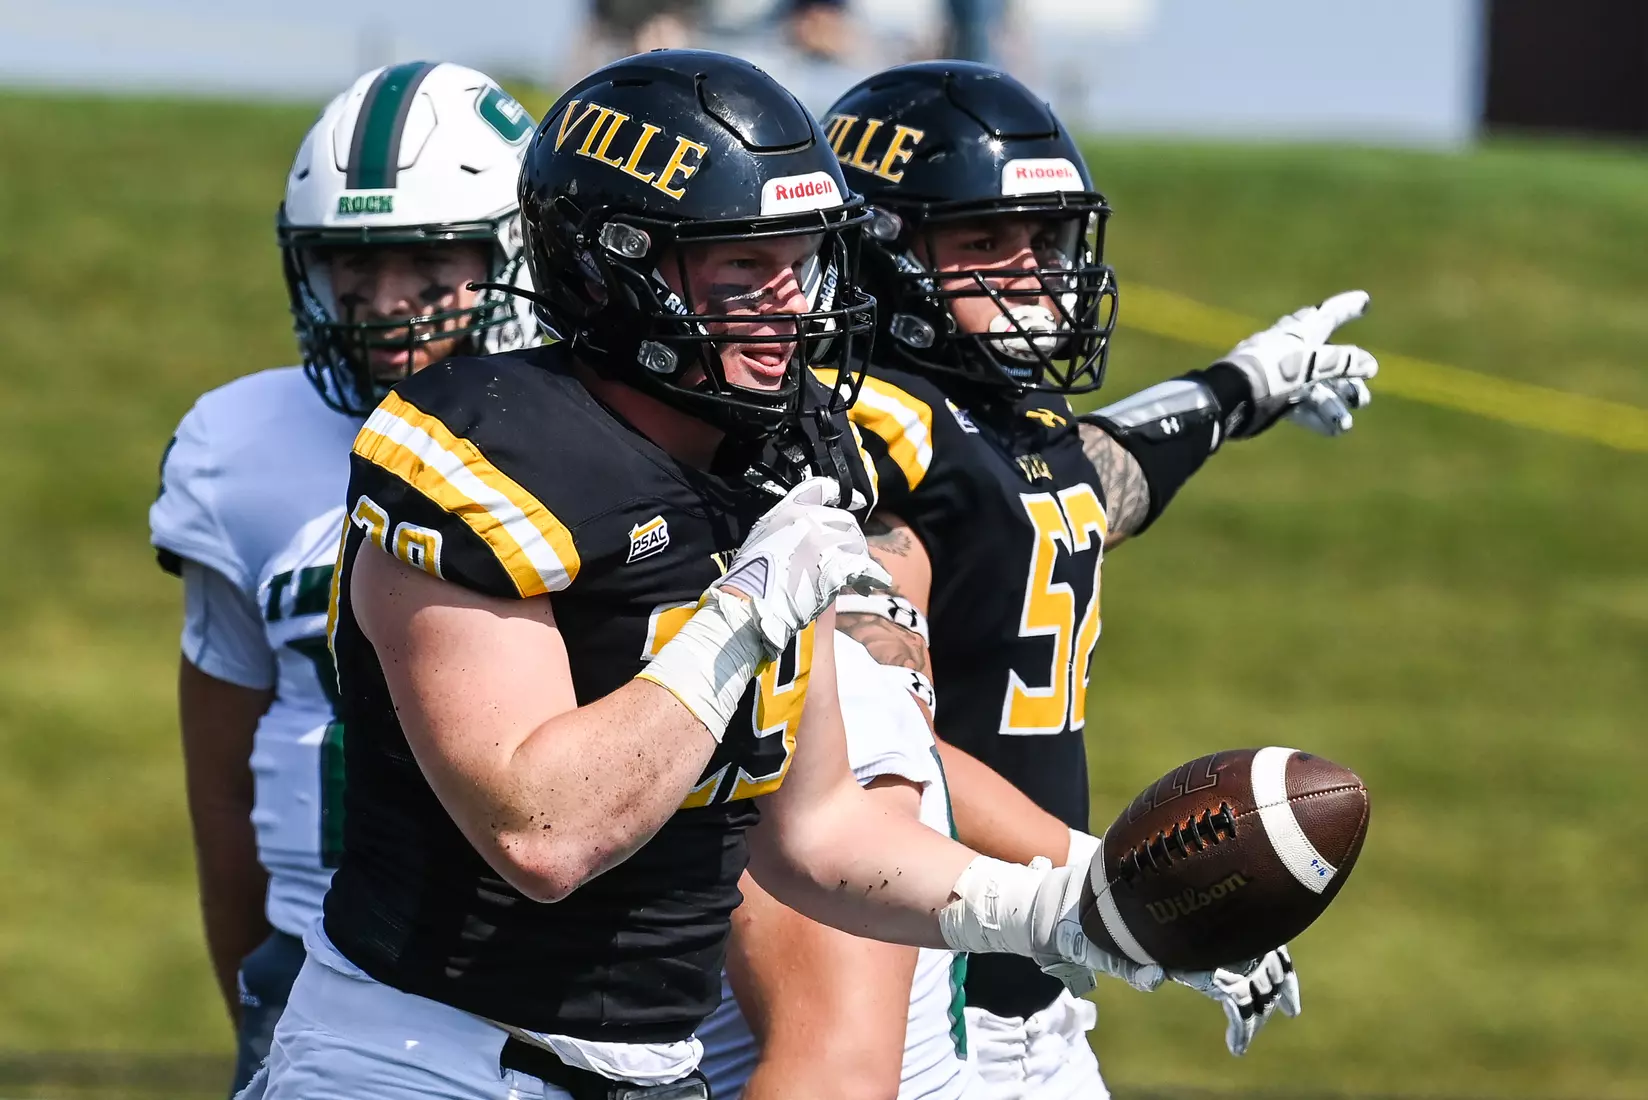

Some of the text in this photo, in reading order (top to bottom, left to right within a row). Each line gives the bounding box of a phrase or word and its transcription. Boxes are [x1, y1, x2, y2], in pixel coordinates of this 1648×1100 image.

[554, 99, 709, 201] VILLE
[820, 113, 924, 184] ILLE
[338, 195, 393, 214] ROCK
[775, 180, 833, 201] Riddell
[631, 524, 667, 556] PSAC
[999, 483, 1109, 735] 52
[1145, 872, 1249, 924] Wilson
